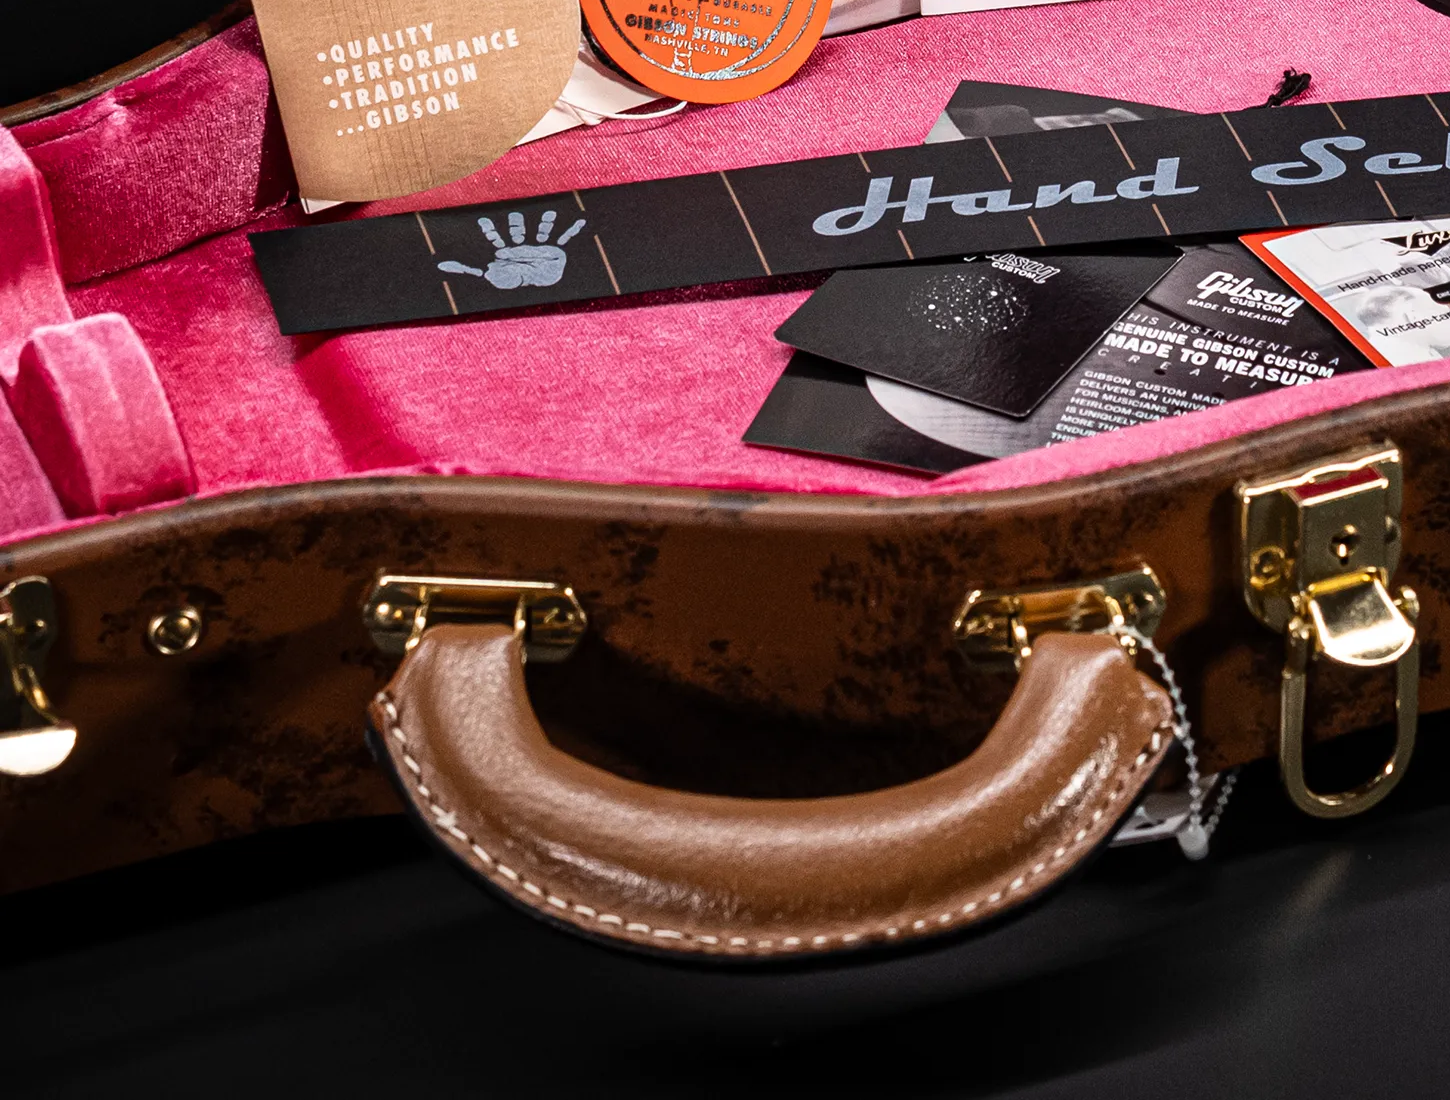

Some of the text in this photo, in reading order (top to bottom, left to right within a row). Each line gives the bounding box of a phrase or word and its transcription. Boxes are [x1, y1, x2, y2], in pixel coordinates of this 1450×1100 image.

[625, 13, 758, 50] GIBSON STRINGS
[813, 156, 1200, 238] Hand
[991, 261, 1037, 280] CUSTOM
[1338, 266, 1417, 293] Hand-made
[1197, 271, 1304, 318] Gibson
[1229, 296, 1283, 313] CUSTOM
[1187, 299, 1290, 326] MADE TO MEASURE
[1113, 321, 1335, 379] GENUINE GIBSON CUSTOM
[1169, 321, 1340, 366] INSTRUMENT IS A
[1103, 333, 1319, 387] MADE TO MEASUR
[1074, 387, 1099, 399] FOR
[1079, 379, 1159, 402] DELIVERS AN
[1084, 370, 1132, 386] GIBSON
[1135, 381, 1188, 398] CUSTOM
